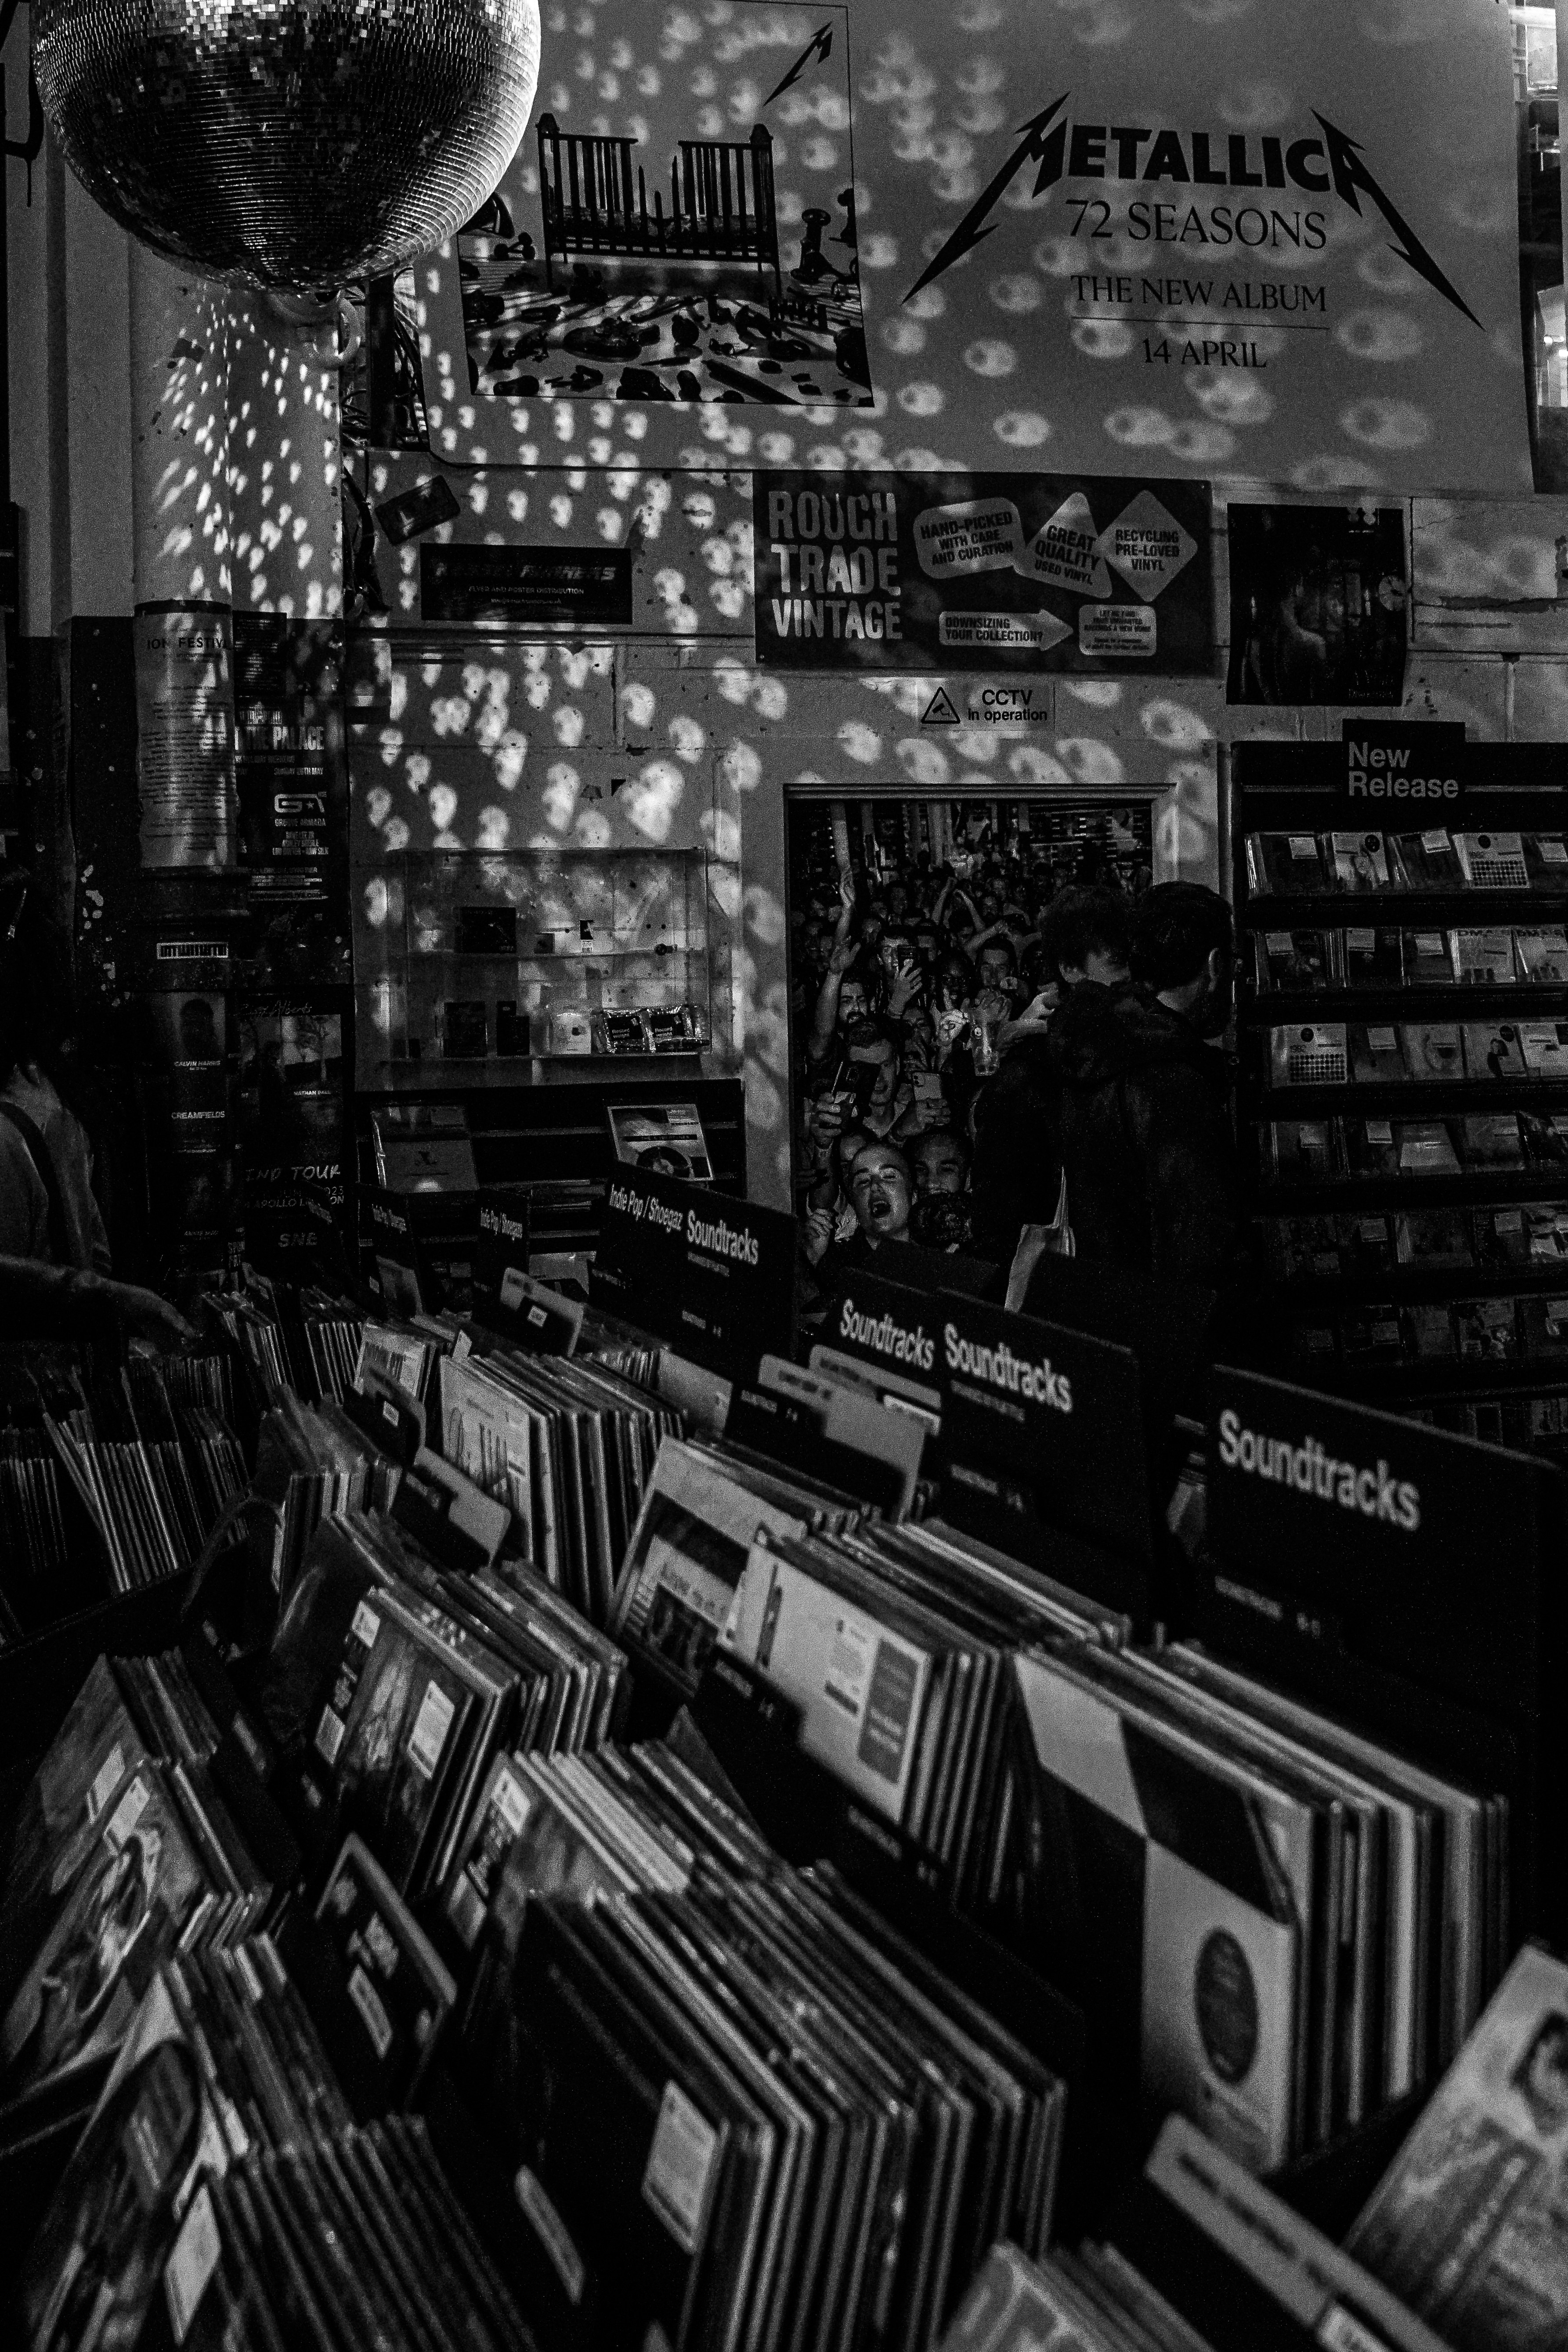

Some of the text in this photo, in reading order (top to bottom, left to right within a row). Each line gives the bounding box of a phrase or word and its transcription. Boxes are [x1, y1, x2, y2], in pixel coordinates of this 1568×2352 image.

[901, 92, 1485, 331] METALLICA
[1065, 199, 1327, 250] 72 SEASONS
[1071, 274, 1327, 312] THE NEW ALBUM
[1142, 338, 1267, 368] 14 APRIL
[768, 491, 898, 541] ROUGH
[920, 512, 1013, 539] HAND-PICKED
[939, 529, 1000, 550] WITH CARE
[1047, 525, 1096, 552] GREAT
[1116, 529, 1179, 543] RECYCLING
[932, 541, 1014, 565] AND CURATION
[1035, 539, 1101, 571] QUALITY
[1116, 544, 1180, 557] PRE-LOVED
[771, 544, 901, 596] TRADE
[1035, 560, 1093, 585] USED VINYL
[1131, 559, 1165, 571] VINYL
[536, 587, 585, 595] DISTRIBUTION
[772, 599, 903, 639] VINTAGE
[945, 617, 1010, 629] DOWNSIZING
[946, 629, 1043, 642] YOUR COLLECTION?
[982, 690, 1032, 705] CCTV
[968, 708, 1048, 723] in operation
[273, 726, 325, 750] PALACE
[1348, 741, 1411, 768] New
[1348, 770, 1459, 798] Release
[171, 1110, 225, 1119] CREAMFIELDS
[290, 1164, 341, 1181] TOUR
[609, 1183, 628, 1211] Indie
[628, 1190, 643, 1222] Pop
[481, 1207, 490, 1229] Indie
[686, 1209, 759, 1266] Soundtracks
[838, 1297, 936, 1372] Soundtracks
[943, 1322, 1073, 1415] Soundtracks
[1218, 1409, 1422, 1533] Soundtracks
